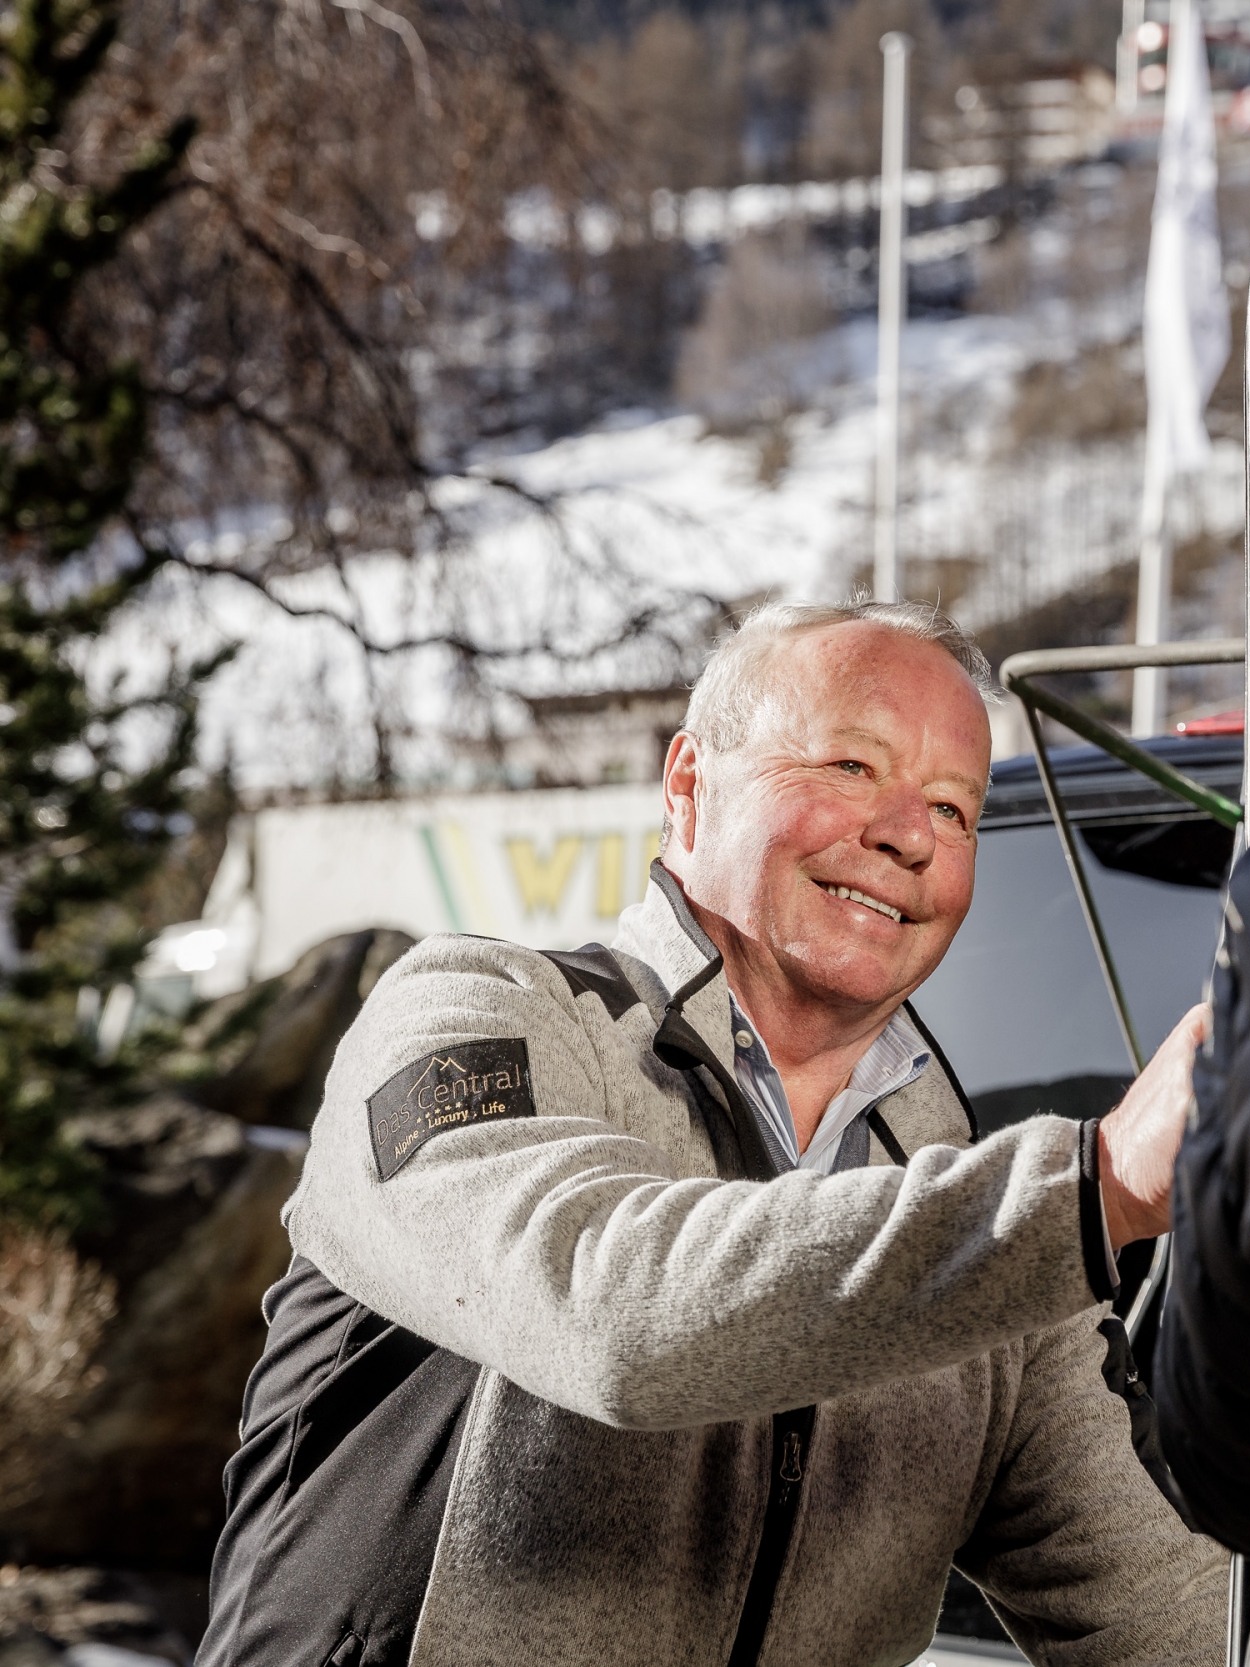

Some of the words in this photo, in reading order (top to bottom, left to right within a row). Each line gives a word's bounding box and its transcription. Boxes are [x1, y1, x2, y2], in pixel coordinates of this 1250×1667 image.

[502, 828, 660, 920] WI
[375, 1102, 411, 1147] Das
[417, 1063, 521, 1110] Central
[393, 1129, 419, 1160] Alpine
[428, 1108, 469, 1130] Luxury
[481, 1101, 506, 1116] Life
